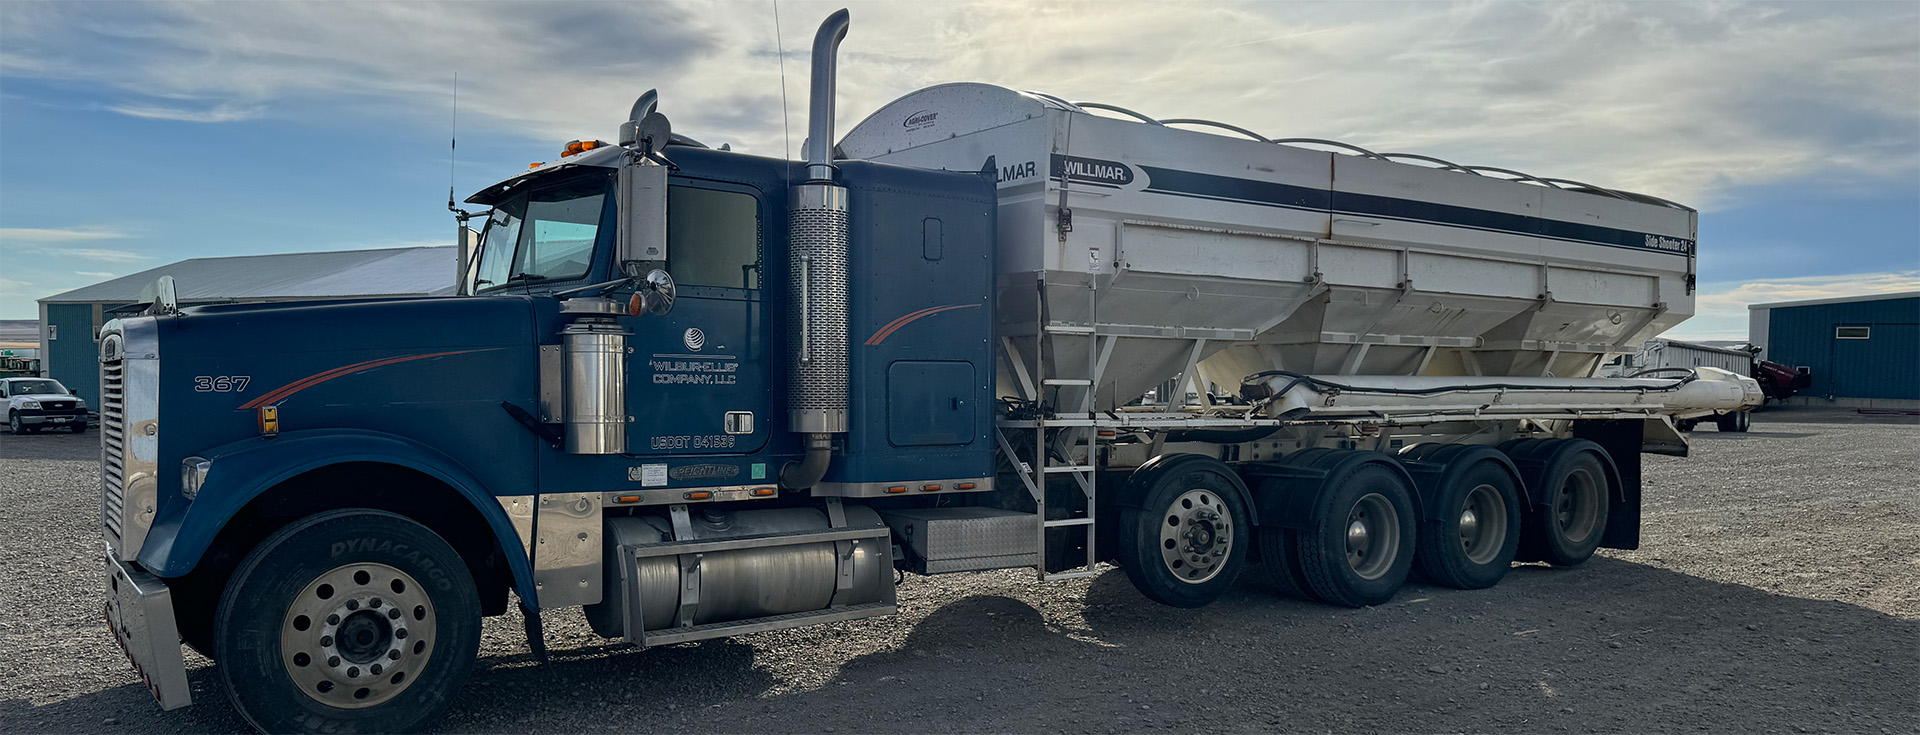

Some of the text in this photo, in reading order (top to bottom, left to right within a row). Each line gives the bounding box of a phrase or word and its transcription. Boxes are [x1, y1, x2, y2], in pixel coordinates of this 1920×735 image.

[997, 161, 1036, 182] LMAR
[1064, 160, 1124, 180] WILLMAR
[1645, 234, 1688, 252] Side Shooter 24
[653, 361, 738, 372] WILBUR-ELLIS
[194, 375, 251, 392] 367
[715, 375, 736, 384] LLC
[651, 436, 691, 449] USDOT
[330, 537, 452, 591] DYNACARGO
